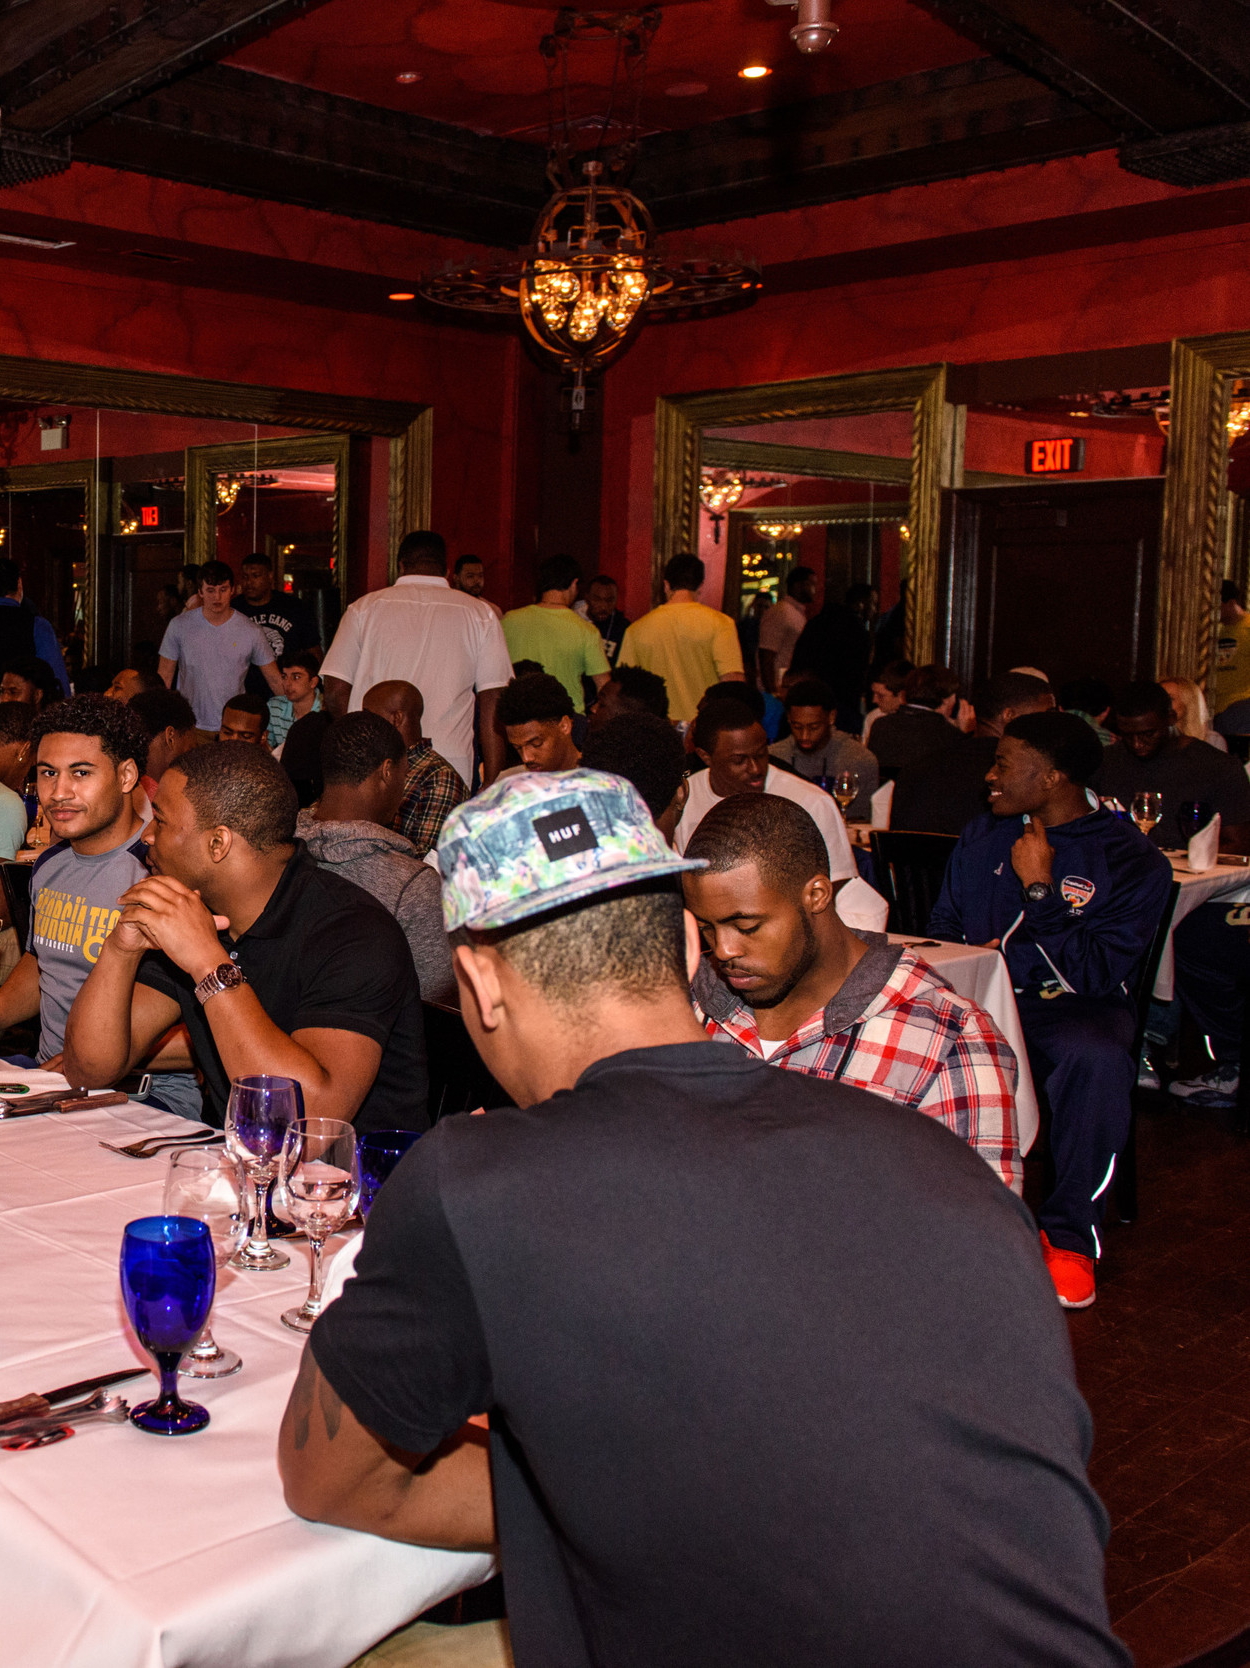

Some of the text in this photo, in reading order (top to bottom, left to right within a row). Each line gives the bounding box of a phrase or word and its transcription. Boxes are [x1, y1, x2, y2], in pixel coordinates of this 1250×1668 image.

[1031, 438, 1074, 472] EXIT
[268, 613, 293, 632] GANG
[547, 823, 581, 844] HUF
[76, 896, 86, 905] OF
